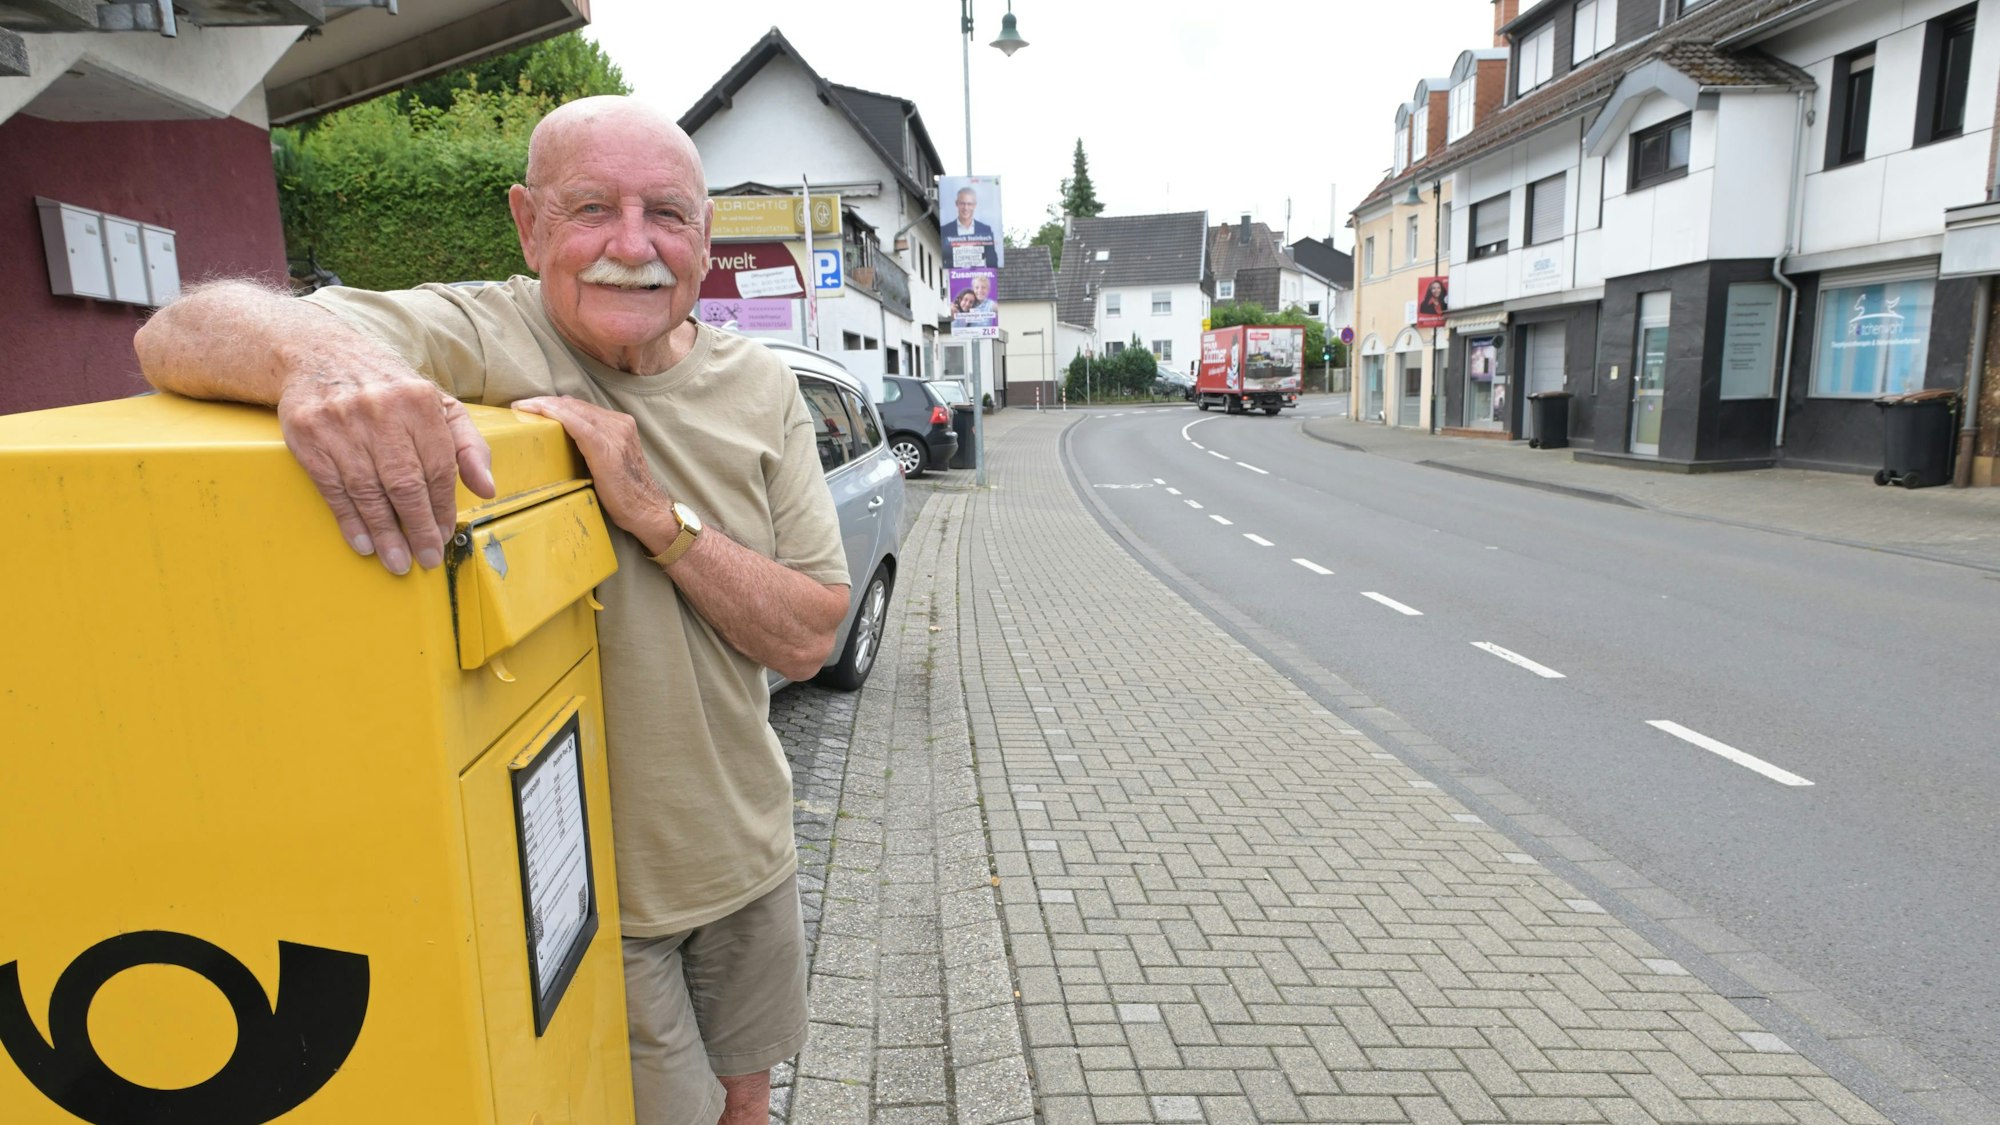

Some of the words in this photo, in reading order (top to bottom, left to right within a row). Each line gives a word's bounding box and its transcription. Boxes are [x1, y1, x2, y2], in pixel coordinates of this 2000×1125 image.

[715, 200, 788, 211] LDRICHTIG
[815, 252, 837, 287] P
[982, 328, 996, 336] ZLR
